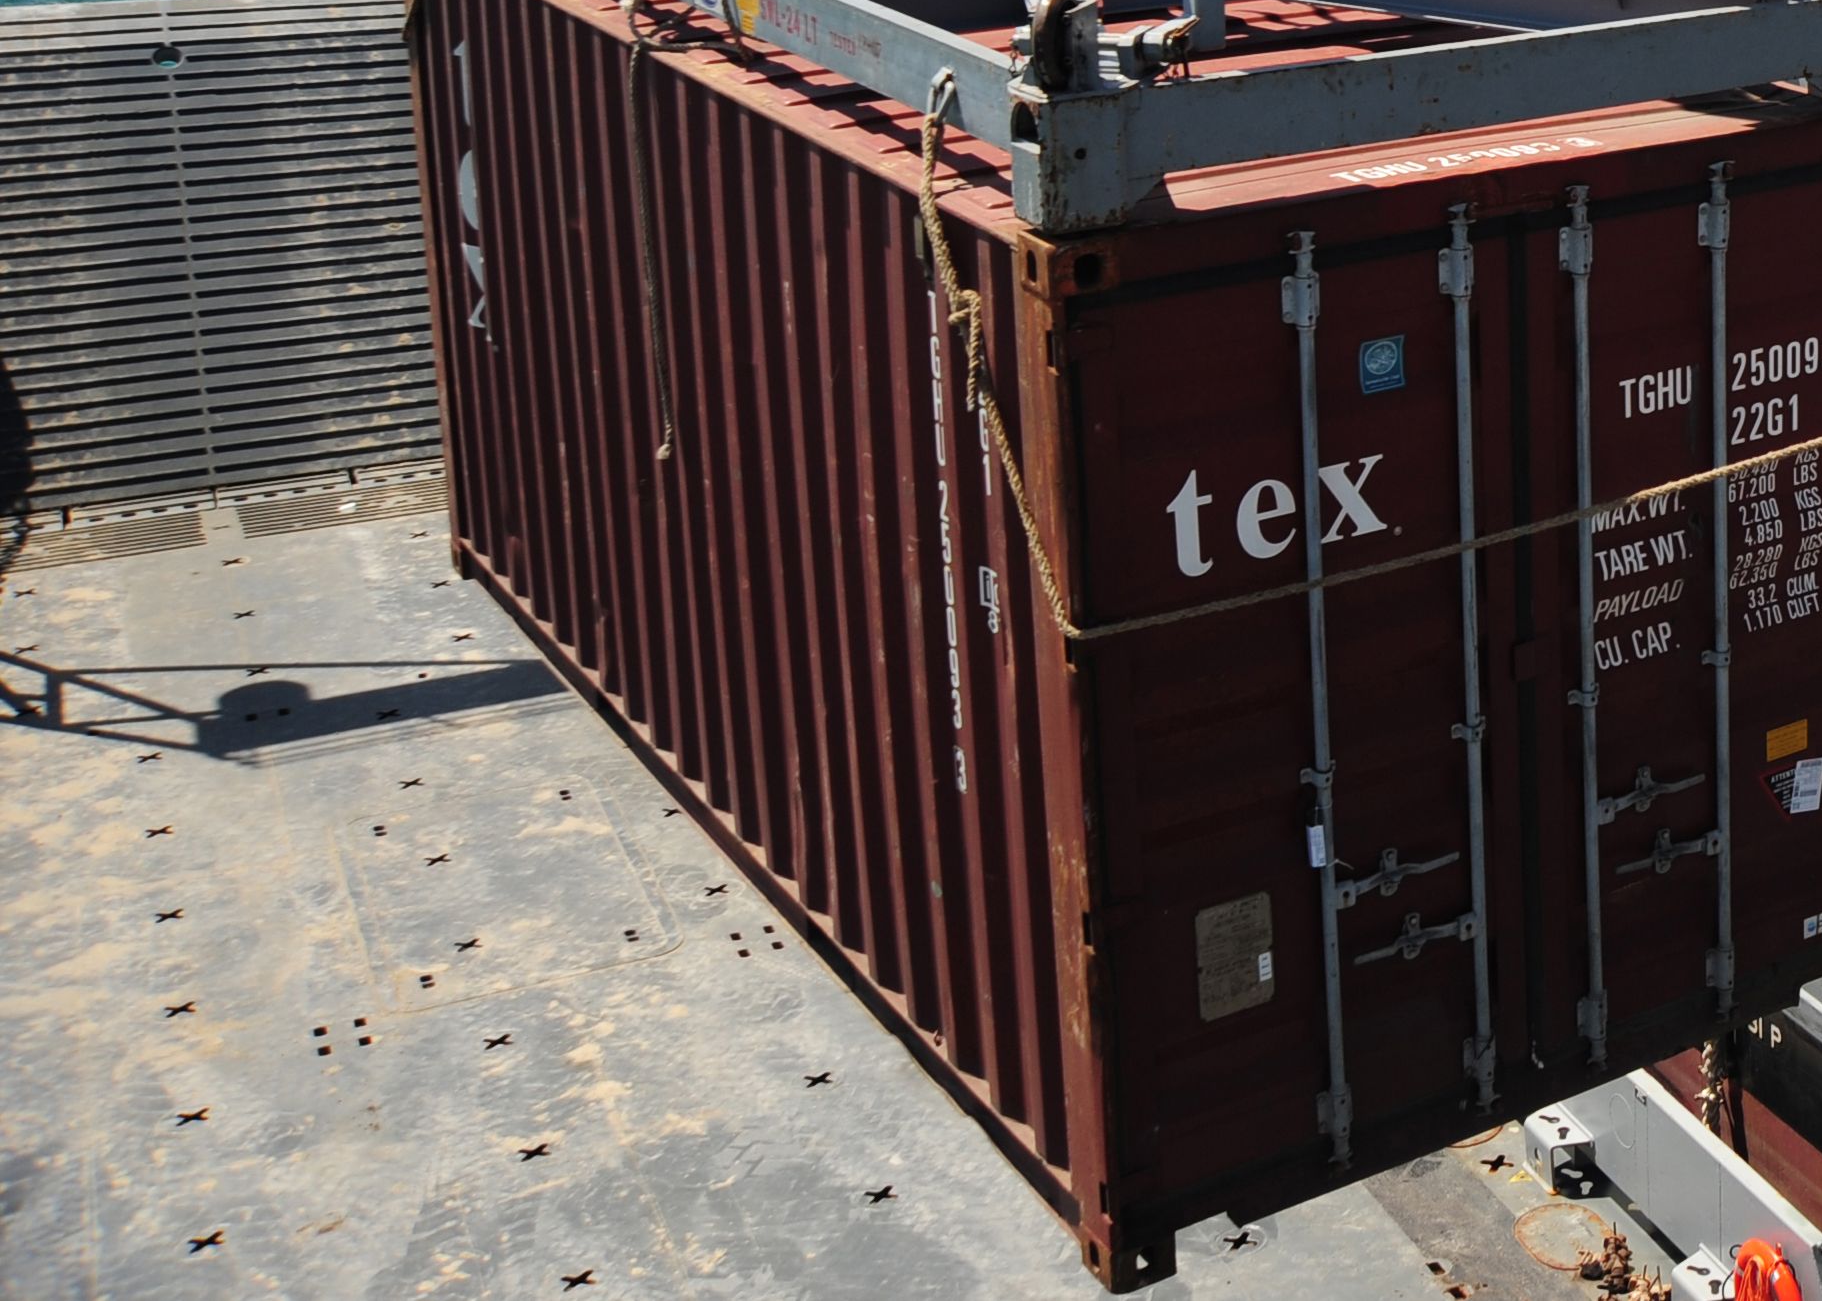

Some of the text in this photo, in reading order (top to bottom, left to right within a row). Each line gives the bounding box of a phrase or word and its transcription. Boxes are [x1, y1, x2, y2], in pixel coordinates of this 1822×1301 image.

[1329, 160, 1428, 184] TGHU
[1619, 365, 1693, 419] TGHU
[1730, 394, 1799, 446] 22G1
[1728, 462, 1818, 503] 67.200 LBS
[1166, 453, 1388, 577] tex
[1739, 486, 1822, 526] 2.200 KGS
[1745, 519, 1782, 546] 4.850
[1594, 530, 1693, 582] TARE WT.
[1730, 550, 1820, 589] 62.350 LBS
[1733, 544, 1783, 571] 28.280
[1593, 578, 1685, 623] PAYLOAD
[1748, 583, 1777, 609] 33.2
[1744, 604, 1782, 632] 1.170
[1594, 621, 1680, 670] CU. CAP.
[1770, 1023, 1782, 1048] P
